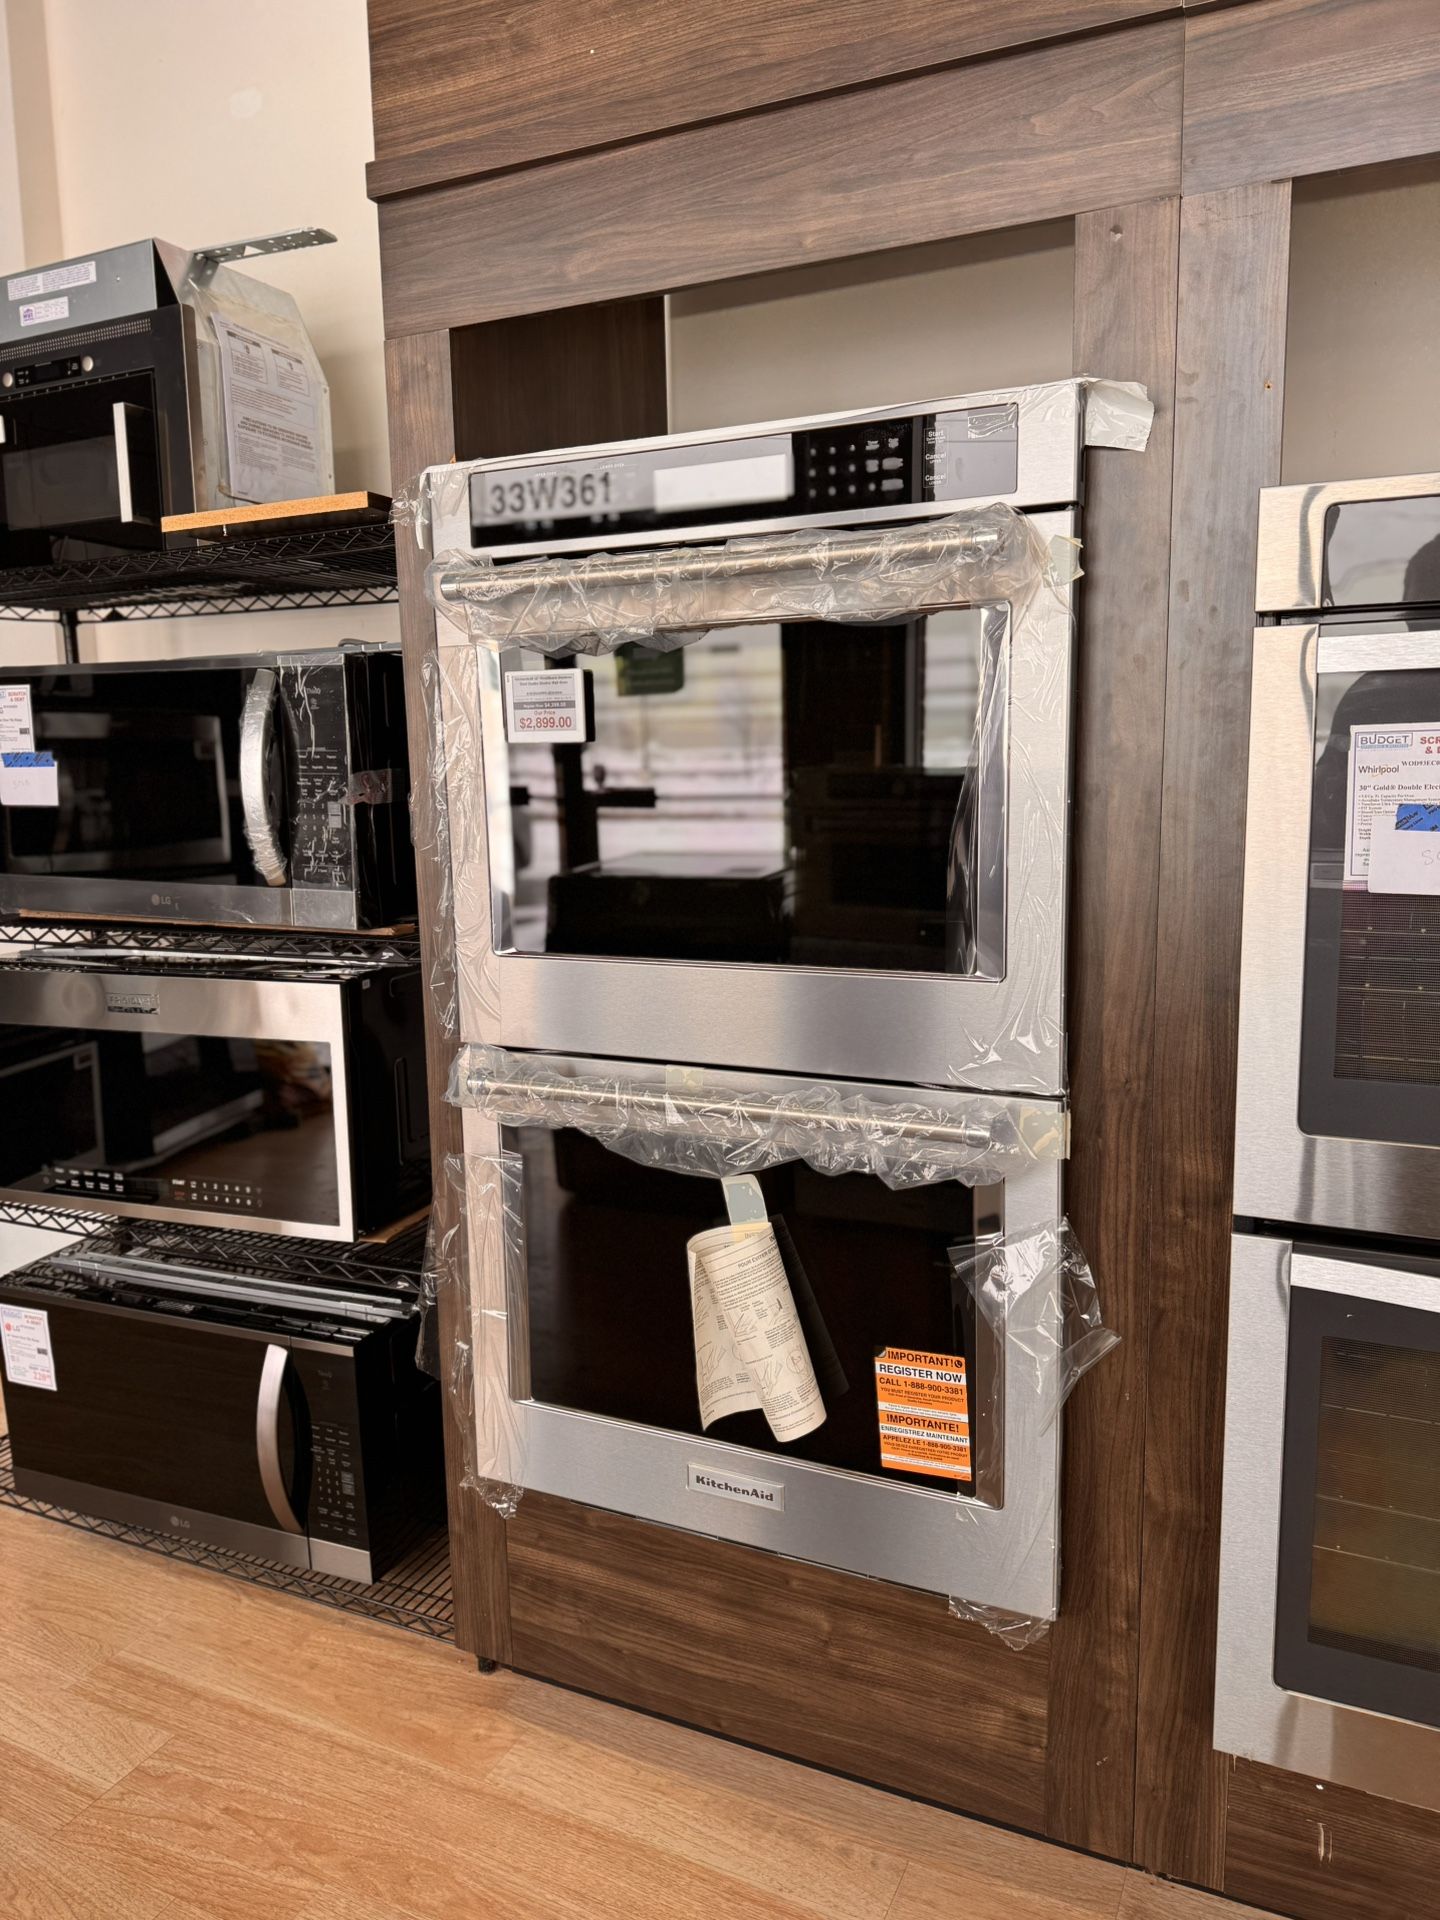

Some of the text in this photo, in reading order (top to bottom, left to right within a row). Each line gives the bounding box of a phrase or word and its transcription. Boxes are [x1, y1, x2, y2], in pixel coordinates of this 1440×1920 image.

[925, 453, 946, 461] Cancel
[925, 474, 946, 482] Cancel
[490, 471, 612, 516] 33W361
[520, 716, 572, 730] $2,899.00
[1360, 734, 1410, 745] BUDGET
[1425, 746, 1432, 754] &
[1358, 765, 1400, 776] Whirlpool
[161, 896, 171, 904] LG
[888, 1350, 954, 1367] IMPORTANT!
[879, 1364, 962, 1382] REGISTER NOW
[879, 1377, 964, 1396] CALL 1-888-900-3381
[886, 1414, 959, 1432] IMPORTANTE!
[881, 1425, 968, 1443] ENREGISTREZ MAINTENANT
[883, 1434, 911, 1444] APPELEZ
[696, 1475, 774, 1502] KitchenAid
